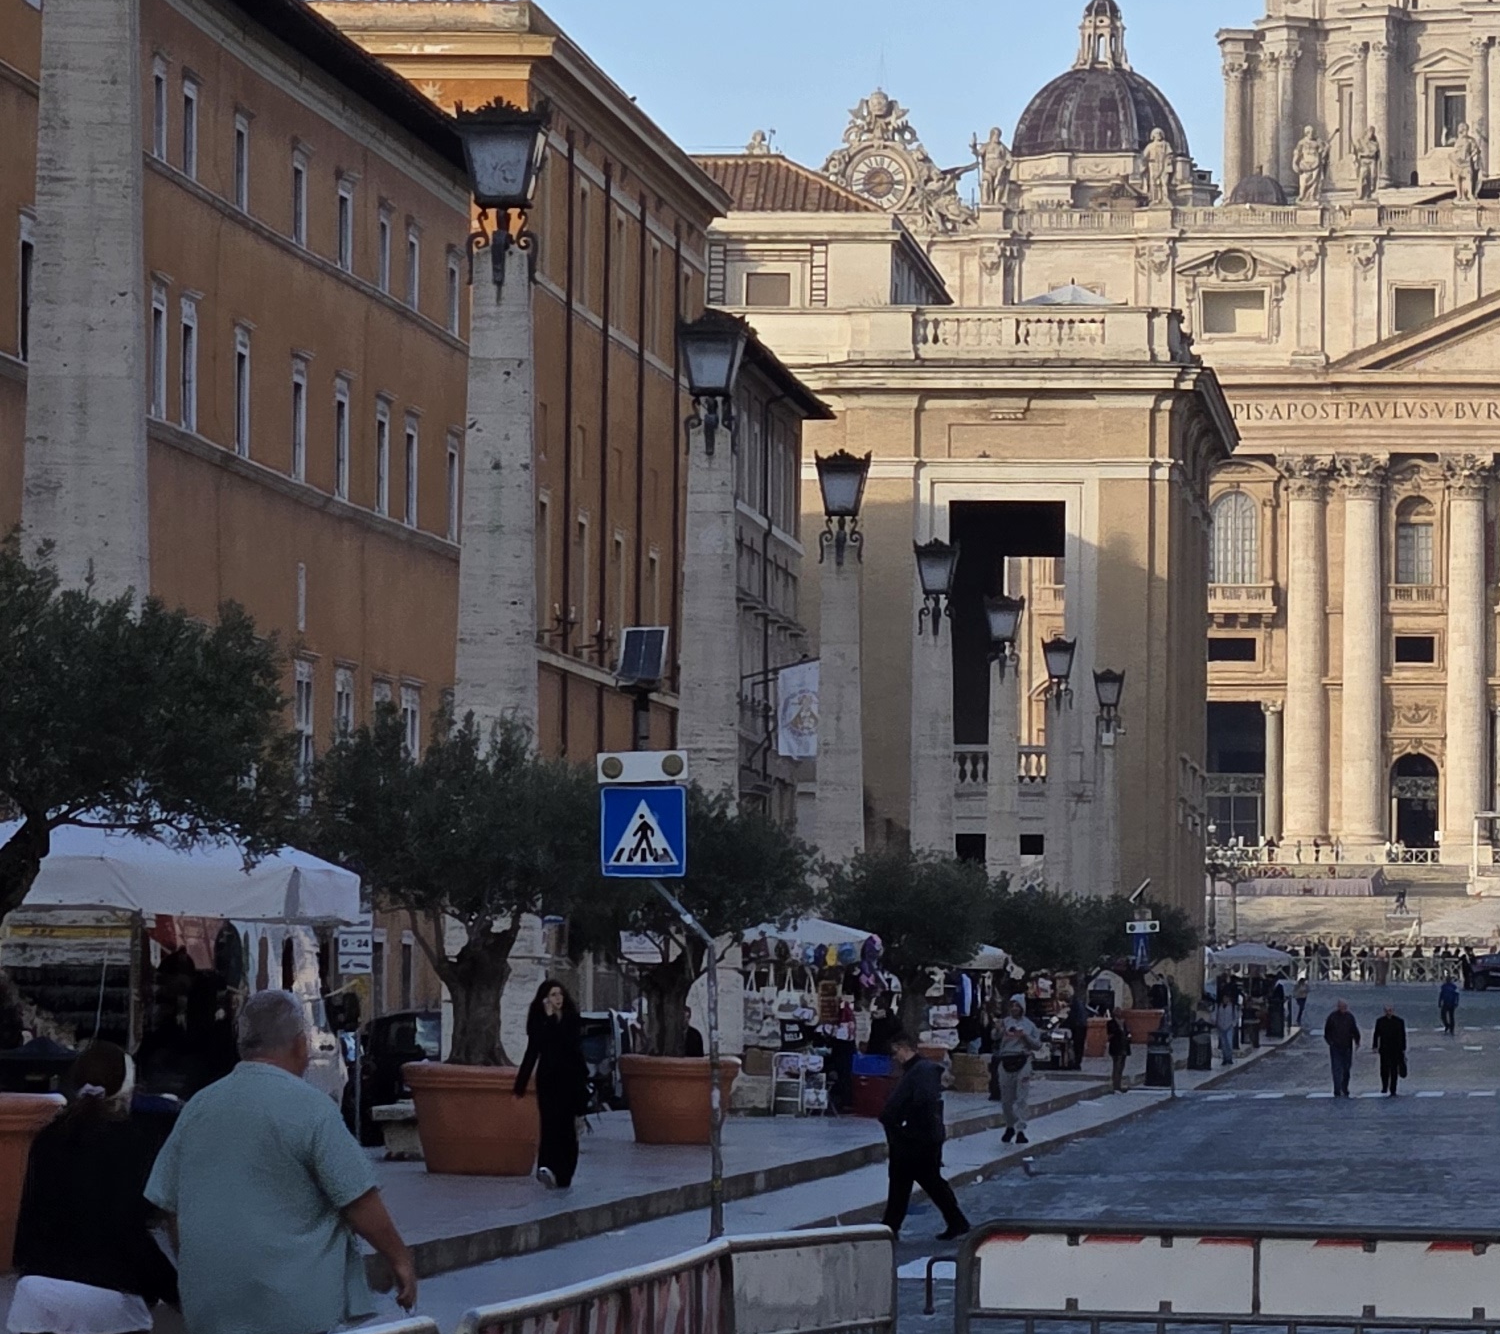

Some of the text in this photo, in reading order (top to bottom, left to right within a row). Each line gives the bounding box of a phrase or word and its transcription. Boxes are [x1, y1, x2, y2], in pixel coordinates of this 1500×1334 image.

[1269, 402, 1344, 420] APOST
[1348, 401, 1429, 419] PAVLVS
[356, 939, 369, 948] 24
